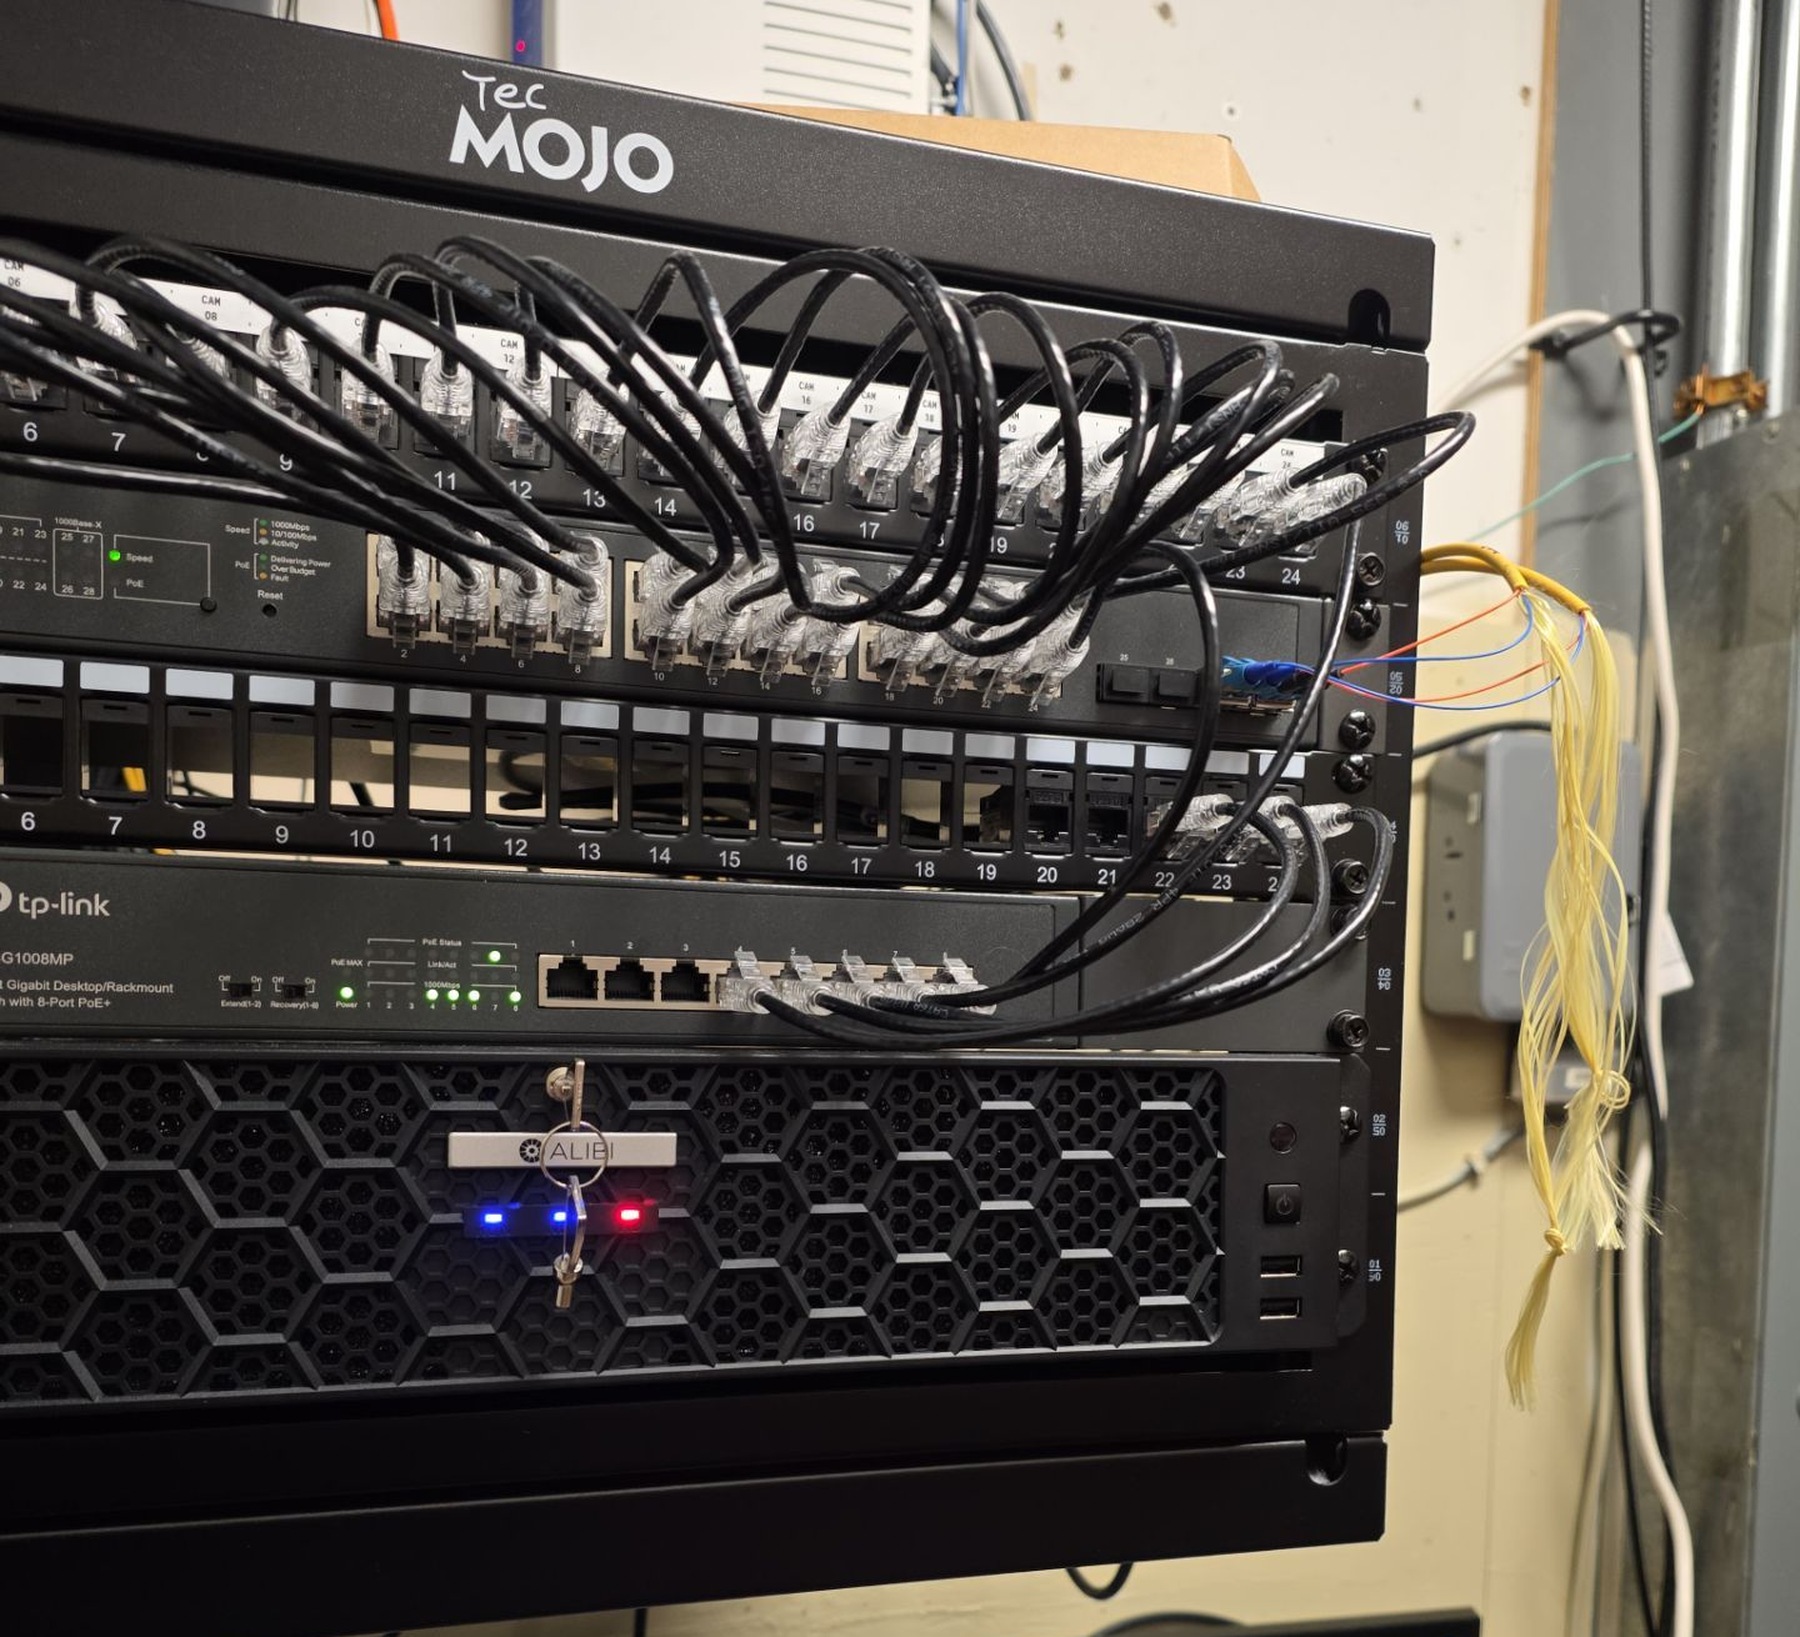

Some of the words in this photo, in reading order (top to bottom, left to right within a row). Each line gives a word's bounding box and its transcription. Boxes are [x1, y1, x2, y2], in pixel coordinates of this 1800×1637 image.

[461, 70, 546, 111] Tec
[450, 104, 674, 193] MOJO
[8, 276, 20, 287] 06
[201, 295, 221, 306] CAM
[205, 311, 217, 321] 08
[500, 338, 519, 349] CAM
[504, 354, 516, 364] 12
[799, 381, 815, 391] CAM
[861, 391, 876, 401] CAM
[923, 400, 938, 410] CAM
[1008, 423, 1017, 433] 19
[1281, 448, 1294, 458] CAM
[24, 422, 37, 441] 6
[112, 432, 125, 451] 7
[435, 471, 455, 492] 11
[509, 480, 532, 499] 12
[583, 489, 606, 507] 13
[655, 497, 676, 515] 14
[794, 514, 814, 531] 16
[860, 522, 880, 538] 17
[991, 537, 1007, 553] 19
[1282, 568, 1300, 584] 24
[225, 525, 250, 534] Speed
[271, 521, 310, 531] 1000Mbps
[1395, 520, 1409, 531] 06
[12, 527, 24, 537] 21
[35, 529, 47, 539] 23
[61, 533, 73, 541] 25
[83, 535, 95, 544] 27
[271, 530, 317, 541] 10/100Mbps
[271, 540, 299, 549] Activity
[126, 553, 153, 564] Speed
[235, 561, 250, 569] PoE
[308, 559, 331, 567] Power
[271, 565, 288, 573] Over
[289, 566, 316, 576] Budget
[12, 580, 25, 589] 22
[35, 582, 47, 591] 24
[61, 585, 73, 594] 26
[83, 587, 95, 595] 28
[126, 579, 144, 588] PoE
[257, 590, 283, 600] Reset
[401, 649, 407, 658] 2
[518, 660, 524, 668] 6
[575, 665, 580, 673] 8
[655, 672, 664, 680] 10
[812, 687, 821, 695] 16
[933, 693, 943, 704] 20
[982, 698, 991, 708] 22
[1029, 701, 1038, 711] 24
[21, 812, 35, 830] 6
[109, 817, 122, 834] 7
[193, 821, 205, 839] 8
[276, 826, 288, 843] 9
[351, 830, 374, 847] 10
[430, 834, 450, 852] 11
[505, 839, 527, 856] 12
[579, 843, 600, 860] 13
[650, 847, 671, 863] 14
[720, 851, 740, 867] 15
[787, 855, 807, 871] 16
[852, 858, 871, 874] 17
[916, 861, 934, 877] 18
[977, 864, 996, 880] 19
[1037, 867, 1057, 882] 20
[1098, 869, 1115, 884] 21
[1155, 872, 1174, 887] 22
[1213, 875, 1231, 890] 23
[19, 892, 110, 919] tp-link
[422, 939, 438, 947] PoE
[440, 939, 462, 947] Status
[331, 959, 345, 967] PoE
[346, 959, 363, 967] MAX
[428, 960, 457, 969] Link/Act
[1378, 968, 1392, 978] 03
[251, 976, 262, 984] On
[7, 979, 50, 992] Gigabit
[53, 980, 174, 993] Desktop/Rackmount
[424, 981, 460, 990] 1000Mbps
[10, 997, 34, 1007] with
[38, 997, 75, 1008] 8-Port
[78, 997, 111, 1008] PoE+
[221, 1000, 261, 1009] Extend(1-2)
[335, 1001, 359, 1009] Power
[367, 1001, 371, 1009] 1
[409, 1002, 414, 1010] 3
[1373, 1114, 1386, 1123] 02
[1369, 1260, 1380, 1268] 01
